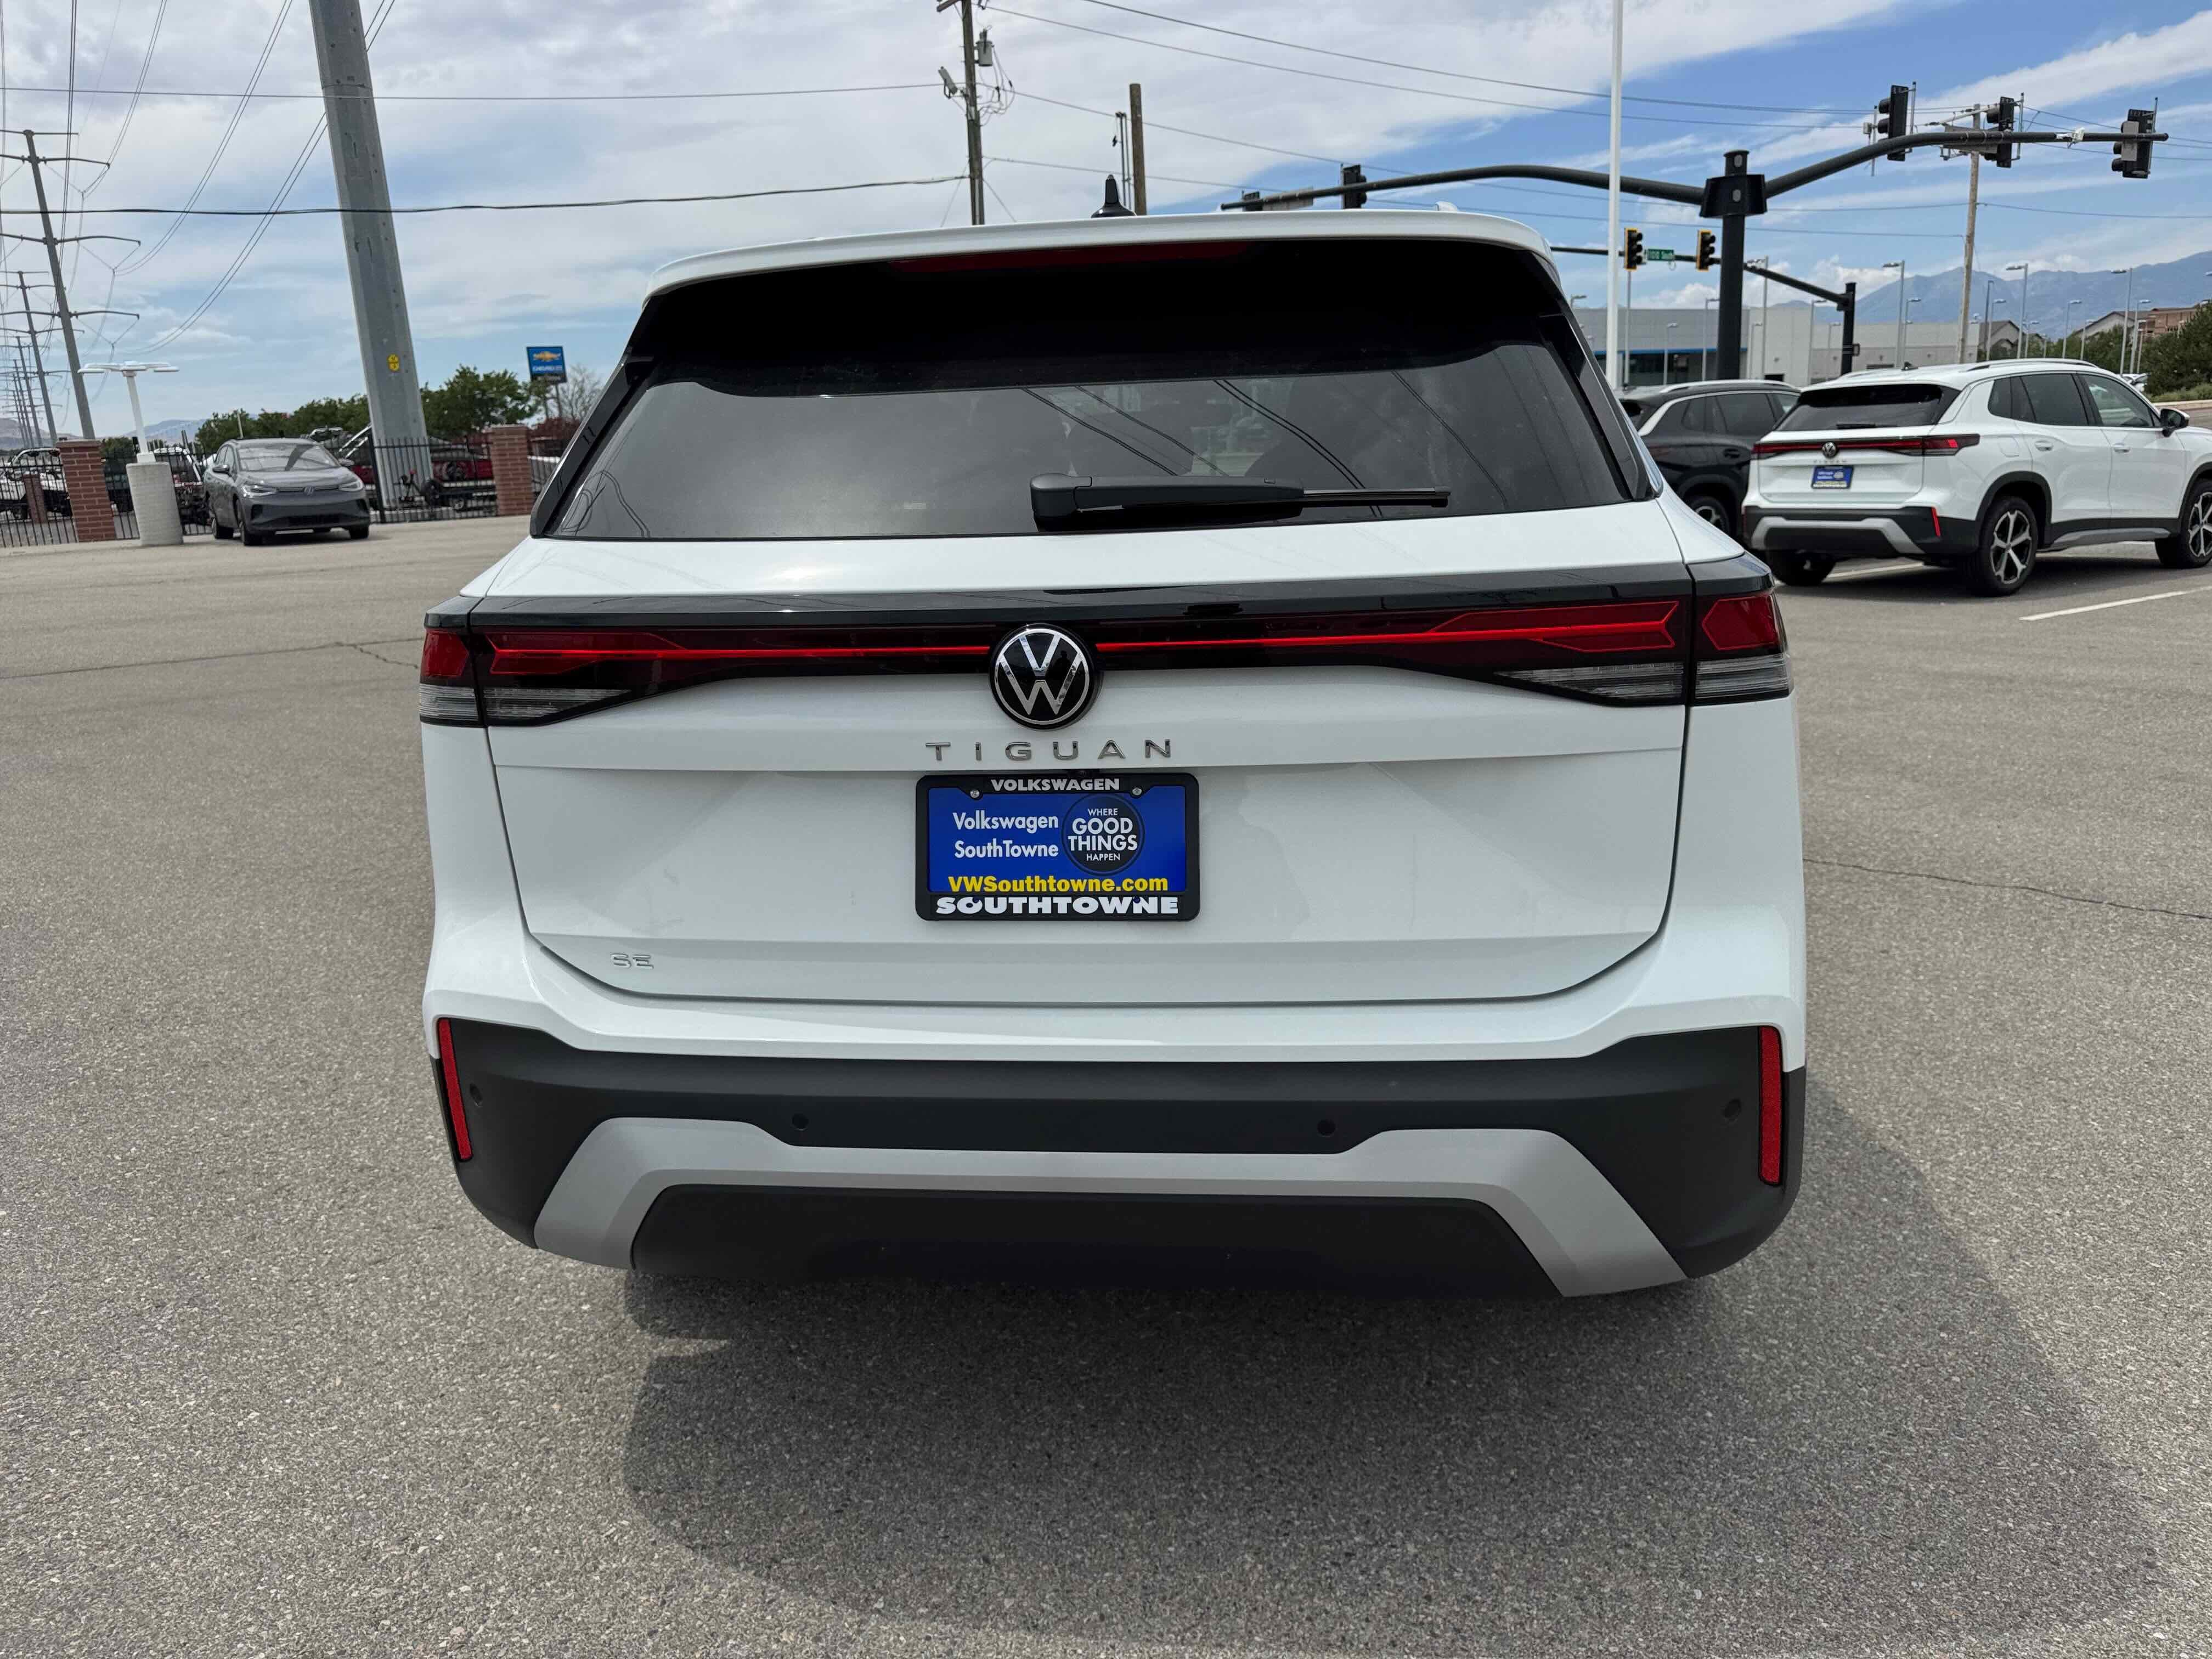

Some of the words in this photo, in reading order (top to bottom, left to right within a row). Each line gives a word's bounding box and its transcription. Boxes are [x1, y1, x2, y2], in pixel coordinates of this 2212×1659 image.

[925, 738, 1172, 761] TIGUAN
[990, 778, 1120, 791] VOLKSWAGEN
[952, 810, 1059, 833] Volkswagen
[1071, 817, 1133, 834] GOOD
[1068, 835, 1138, 851] THINGS
[1086, 853, 1120, 861] HAPPEN
[948, 875, 1168, 892] VWSouthtowne.com
[935, 896, 1178, 915] SOUTHTOWNE
[610, 953, 654, 969] SE
